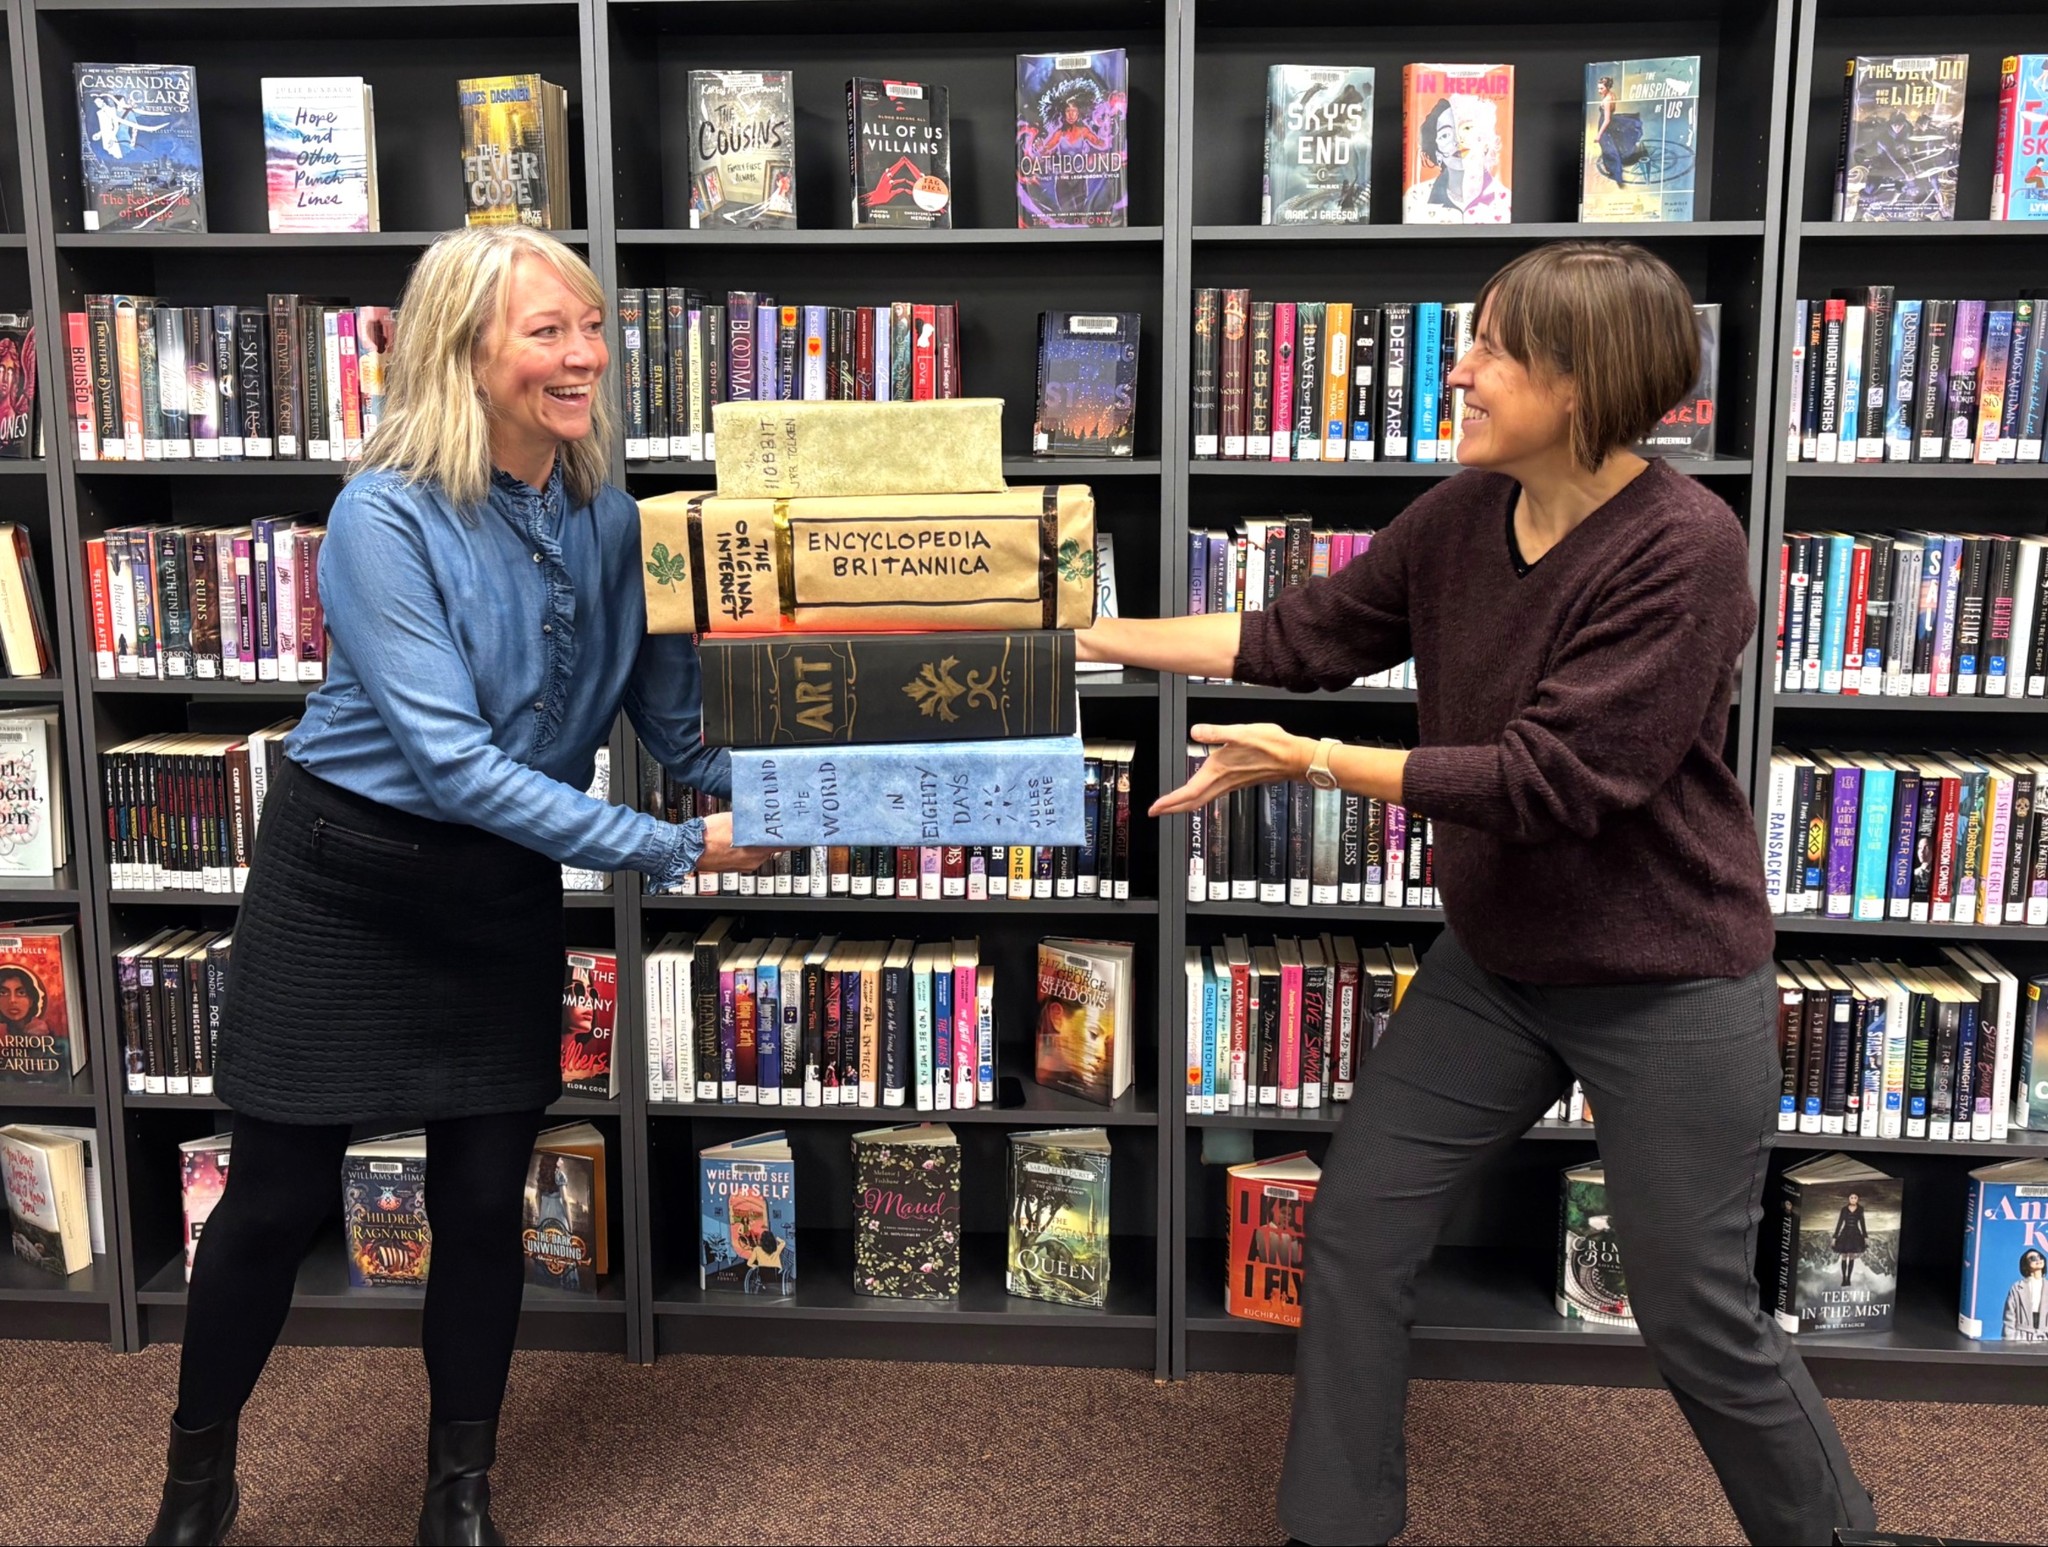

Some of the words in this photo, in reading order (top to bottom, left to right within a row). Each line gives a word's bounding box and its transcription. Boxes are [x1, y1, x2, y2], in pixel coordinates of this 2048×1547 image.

[82, 75, 185, 89] CASSANDRA
[1416, 74, 1436, 93] IN
[1444, 74, 1509, 94] REPAIR
[1646, 72, 1656, 80] THE
[1868, 63, 1893, 79] THE
[130, 90, 189, 104] CLARE
[1891, 83, 1952, 106] LIGHT
[295, 107, 338, 126] Hope
[715, 104, 735, 122] THE
[1288, 103, 1362, 131] SKY'S
[1667, 101, 1682, 119] US
[302, 127, 333, 144] and
[698, 120, 785, 160] COUSINS
[863, 122, 889, 136] ALL
[896, 125, 917, 138] OF
[924, 127, 943, 139] US
[296, 148, 341, 166] Other
[478, 144, 499, 157] THE
[868, 139, 938, 154] VILLAINS
[1298, 136, 1350, 164] END
[464, 152, 539, 182] FEVER
[1020, 152, 1122, 176] OATHBOUND
[294, 170, 345, 188] Punch
[99, 194, 124, 205] The
[298, 192, 343, 208] Lines
[471, 179, 532, 206] CODE
[1285, 210, 1308, 220] MARC
[1320, 210, 1358, 220] GREGSON
[240, 341, 258, 374] SKY
[1390, 325, 1405, 370] DEFY
[1825, 335, 1838, 375] HIDDEN
[72, 346, 88, 403] BRUISED
[631, 349, 640, 388] WONDER
[784, 357, 792, 371] THE
[917, 356, 928, 385] LOVE
[1302, 337, 1316, 389] BEASTS
[1928, 344, 1940, 385] AURORA
[654, 365, 663, 406] BATMAN
[675, 349, 684, 423] SUPERMAN
[1254, 350, 1270, 431] RULE
[1279, 370, 1290, 421] DIAMOND
[1845, 380, 1857, 413] RULES
[1952, 380, 1976, 391] END
[244, 380, 260, 430] STARS
[633, 389, 641, 424] WOMAN
[1329, 393, 1337, 417] DARK
[1386, 388, 1403, 438] STARS
[1822, 378, 1835, 431] MONSTERS
[1925, 387, 1936, 419] RISING
[1298, 406, 1312, 438] PREY
[807, 530, 992, 553] ENCYCLOPEDIA
[754, 539, 771, 572] THE
[832, 556, 990, 576] BRITANNICA
[717, 532, 738, 621] INTERNET
[736, 520, 754, 619] ORIGINAL
[94, 573, 104, 599] FELIX
[165, 560, 180, 634] PATHFINDER
[1812, 580, 1824, 594] THE
[195, 578, 208, 621] RUINS
[96, 601, 104, 625] EVER
[301, 607, 316, 642] FIRE
[1791, 624, 1802, 638] TWO
[793, 656, 834, 734] ART
[761, 758, 784, 840] AROUND
[797, 791, 811, 817] THE
[819, 761, 839, 838] WORLD
[886, 793, 905, 811] IN
[915, 765, 940, 840] EIGHTY
[945, 772, 972, 825] DAYS
[1028, 777, 1041, 828] JULES
[1042, 775, 1056, 826] VERNE
[1996, 802, 2009, 819] SHE
[1342, 796, 1358, 865] EVERLESS
[1945, 812, 1954, 828] SIX
[1970, 811, 1979, 824] THE
[1084, 817, 1094, 857] PALADIN
[1192, 816, 1201, 847] ROYCE
[1901, 820, 1912, 855] FEVER
[1993, 821, 2006, 847] GETS
[2016, 824, 2024, 841] THE
[1766, 812, 1785, 896] RANSACKER
[1942, 830, 1952, 863] CRIMSON
[1992, 847, 2004, 866] THE
[2014, 841, 2022, 865] BONE
[1897, 858, 1908, 886] KING
[1939, 865, 1950, 896] CRANES
[1988, 868, 2002, 894] GIRL
[2010, 867, 2020, 896] HOUSES
[207, 964, 216, 998] CONDIE
[216, 970, 224, 993] ALLY
[577, 968, 589, 978] IN
[593, 970, 615, 983] THE
[1038, 973, 1055, 984] THE
[1056, 978, 1080, 992] EDGE
[1056, 969, 1107, 991] GEORGE
[1040, 982, 1106, 1010] SHADOWS
[1236, 990, 1244, 1018] CRANE
[1306, 991, 1324, 1024] FIVE
[210, 1005, 219, 1027] POE
[699, 994, 718, 1056] LEGENDARY
[938, 1018, 947, 1033] THE
[1205, 987, 1214, 1042] CHALLENGE
[1342, 1009, 1350, 1029] GIRL
[593, 1027, 611, 1039] OF
[827, 1031, 836, 1055] RED
[1786, 1011, 1799, 1059] ASHFALL
[1812, 1012, 1824, 1060] ASHFALL
[1866, 1031, 1883, 1056] STARS
[3, 1048, 30, 1058] GIRL
[1910, 1039, 1929, 1090] WILDCARD
[1961, 1047, 1972, 1093] MIDNIGHT
[567, 1082, 587, 1091] ELORA
[589, 1085, 607, 1093] COOK
[1958, 1095, 1970, 1121] STAR
[348, 1171, 392, 1181] WILLIAMS
[393, 1172, 426, 1182] CHIMA
[706, 1168, 744, 1182] WHERE
[770, 1171, 790, 1183] SEE
[707, 1182, 790, 1199] YOURSELF
[864, 1187, 947, 1217] Maud
[356, 1212, 422, 1225] CHILDREN
[1240, 1190, 1249, 1224] I
[352, 1225, 430, 1243] RAGNAROK
[1051, 1216, 1068, 1226] THE
[1783, 1216, 1792, 1248] TEETH
[527, 1240, 581, 1260] UNWINDING
[536, 1232, 549, 1242] THE
[552, 1234, 571, 1246] DARK
[1017, 1249, 1096, 1281] QUEEN
[1780, 1266, 1789, 1287] THE
[1244, 1264, 1254, 1298] I
[1821, 1290, 1871, 1304] TEETH
[1244, 1307, 1280, 1320] RUCHIRA
[1801, 1307, 1817, 1320] IN
[1820, 1306, 1850, 1318] THE
[1854, 1304, 1890, 1317] MIST
